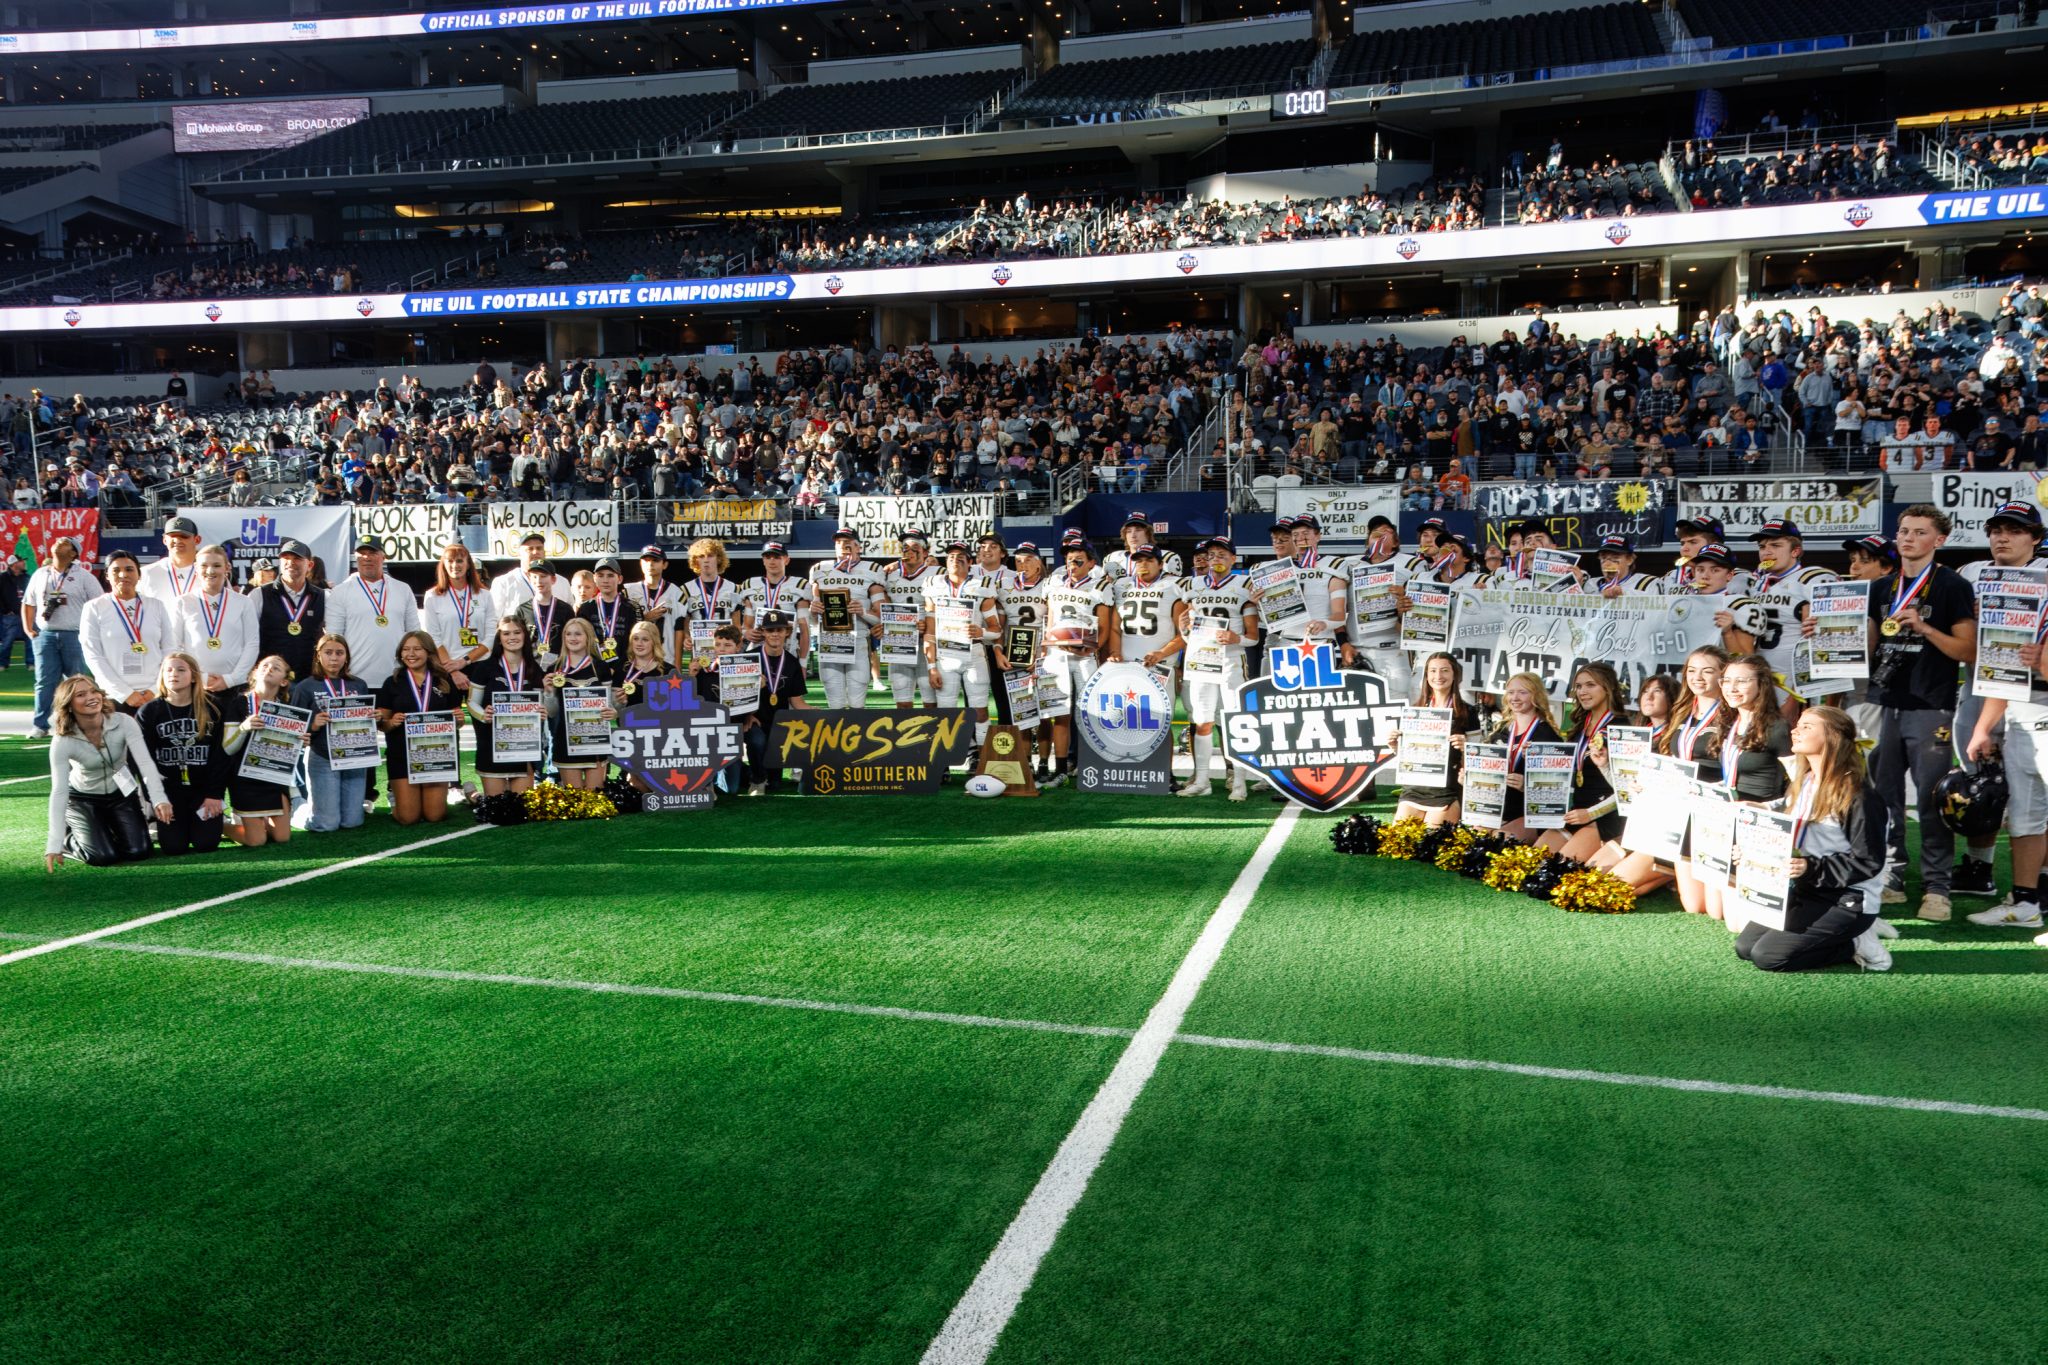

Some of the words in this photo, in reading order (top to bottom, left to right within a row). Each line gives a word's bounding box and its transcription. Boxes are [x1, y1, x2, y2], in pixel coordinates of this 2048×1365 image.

[429, 14, 493, 30] OFFICIAL
[498, 9, 566, 26] SPONSOR
[571, 7, 589, 20] OF
[596, 4, 624, 18] THE
[629, 2, 653, 17] UIL
[658, 0, 733, 14] FOOTBALL
[1286, 90, 1325, 115] 0:00
[198, 123, 235, 134] Mohawk
[236, 122, 264, 134] Group
[1933, 196, 1992, 220] THE
[1997, 192, 2046, 215] UIL
[410, 297, 444, 313] THE
[447, 295, 476, 312] UIL
[481, 291, 570, 310] FOOTBALL
[575, 288, 631, 306] STATE
[637, 280, 788, 304] CHAMPIONSHIPS
[1328, 490, 1348, 498] ONLY
[1625, 491, 1641, 504] Hit
[1701, 483, 1739, 501] WE
[1747, 481, 1838, 501] BLEED
[1943, 475, 2012, 508] Bring
[845, 500, 886, 518] LAST
[895, 498, 936, 518] YEAR
[942, 494, 993, 517] WASN'T
[1488, 486, 1598, 517] HUSTLE
[50, 509, 89, 530] PLAY
[358, 506, 416, 535] HOOK
[491, 504, 515, 529] We
[563, 501, 612, 529] Good
[1320, 513, 1355, 523] WEAR
[1784, 504, 1860, 525] GOLD
[656, 523, 664, 537] A
[667, 523, 689, 537] CUT
[693, 522, 733, 537] ABOVE
[735, 522, 760, 536] THE
[762, 521, 793, 535] REST
[963, 518, 993, 538] BACK
[1155, 523, 1167, 533] EXIT
[1850, 523, 1877, 531] FAMILY
[384, 533, 450, 561] ORNS
[572, 530, 617, 554] medals
[823, 578, 864, 586] GORDON
[1005, 595, 1048, 605] GORDON
[1052, 594, 1091, 606] GORDON
[1121, 590, 1164, 599] GORDON
[1483, 591, 1510, 603] 2024
[1513, 592, 1558, 606] GORDON
[1122, 600, 1158, 636] 25
[1510, 604, 1541, 615] TEXAS
[1546, 606, 1586, 618] SIXMAN
[1506, 616, 1562, 658] Back
[1589, 617, 1637, 661] Back
[1649, 630, 1687, 655] 15-0
[1013, 647, 1029, 655] MVP
[1271, 644, 1344, 690] UIL
[565, 699, 582, 709] STATE
[647, 680, 700, 711] UIL
[1264, 691, 1360, 710] FOOTBALL
[494, 703, 512, 714] STATE
[1099, 692, 1160, 730] UIL
[407, 724, 425, 736] STATE
[425, 722, 454, 733] CHAMPS!
[776, 718, 862, 763] RING
[851, 709, 966, 764] SZN
[1228, 705, 1402, 753] STATE
[611, 725, 740, 758] STATE
[644, 756, 710, 769] CHAMPIONS
[1260, 753, 1276, 767] 1A
[1298, 752, 1305, 766] 1
[1305, 749, 1376, 765] CHAMPIONS
[843, 765, 927, 782] SOUTHERN
[1103, 768, 1165, 783] SOUTHERN
[663, 793, 710, 805] SOUTHERN
